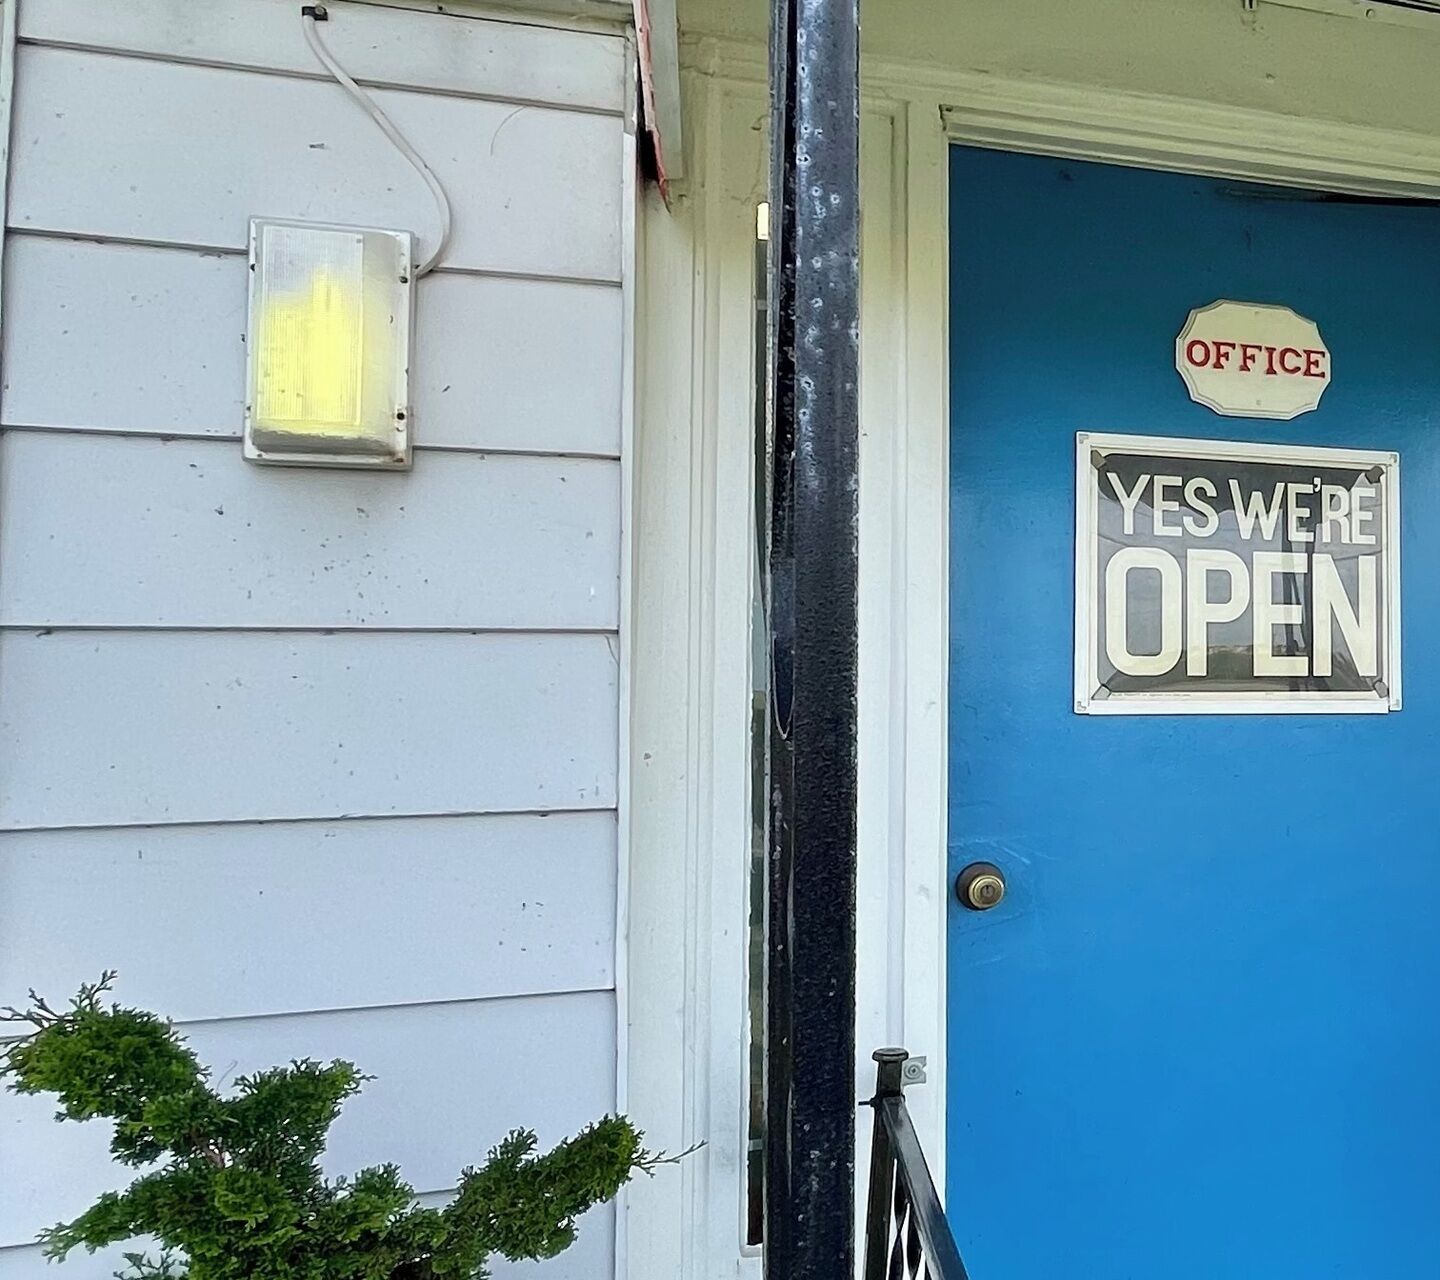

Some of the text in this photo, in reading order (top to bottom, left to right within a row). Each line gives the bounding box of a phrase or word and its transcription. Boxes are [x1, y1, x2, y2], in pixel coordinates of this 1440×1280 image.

[1186, 339, 1326, 378] OFFICE
[1105, 471, 1377, 545] YES WE'RE
[1104, 546, 1378, 677] OPEN
